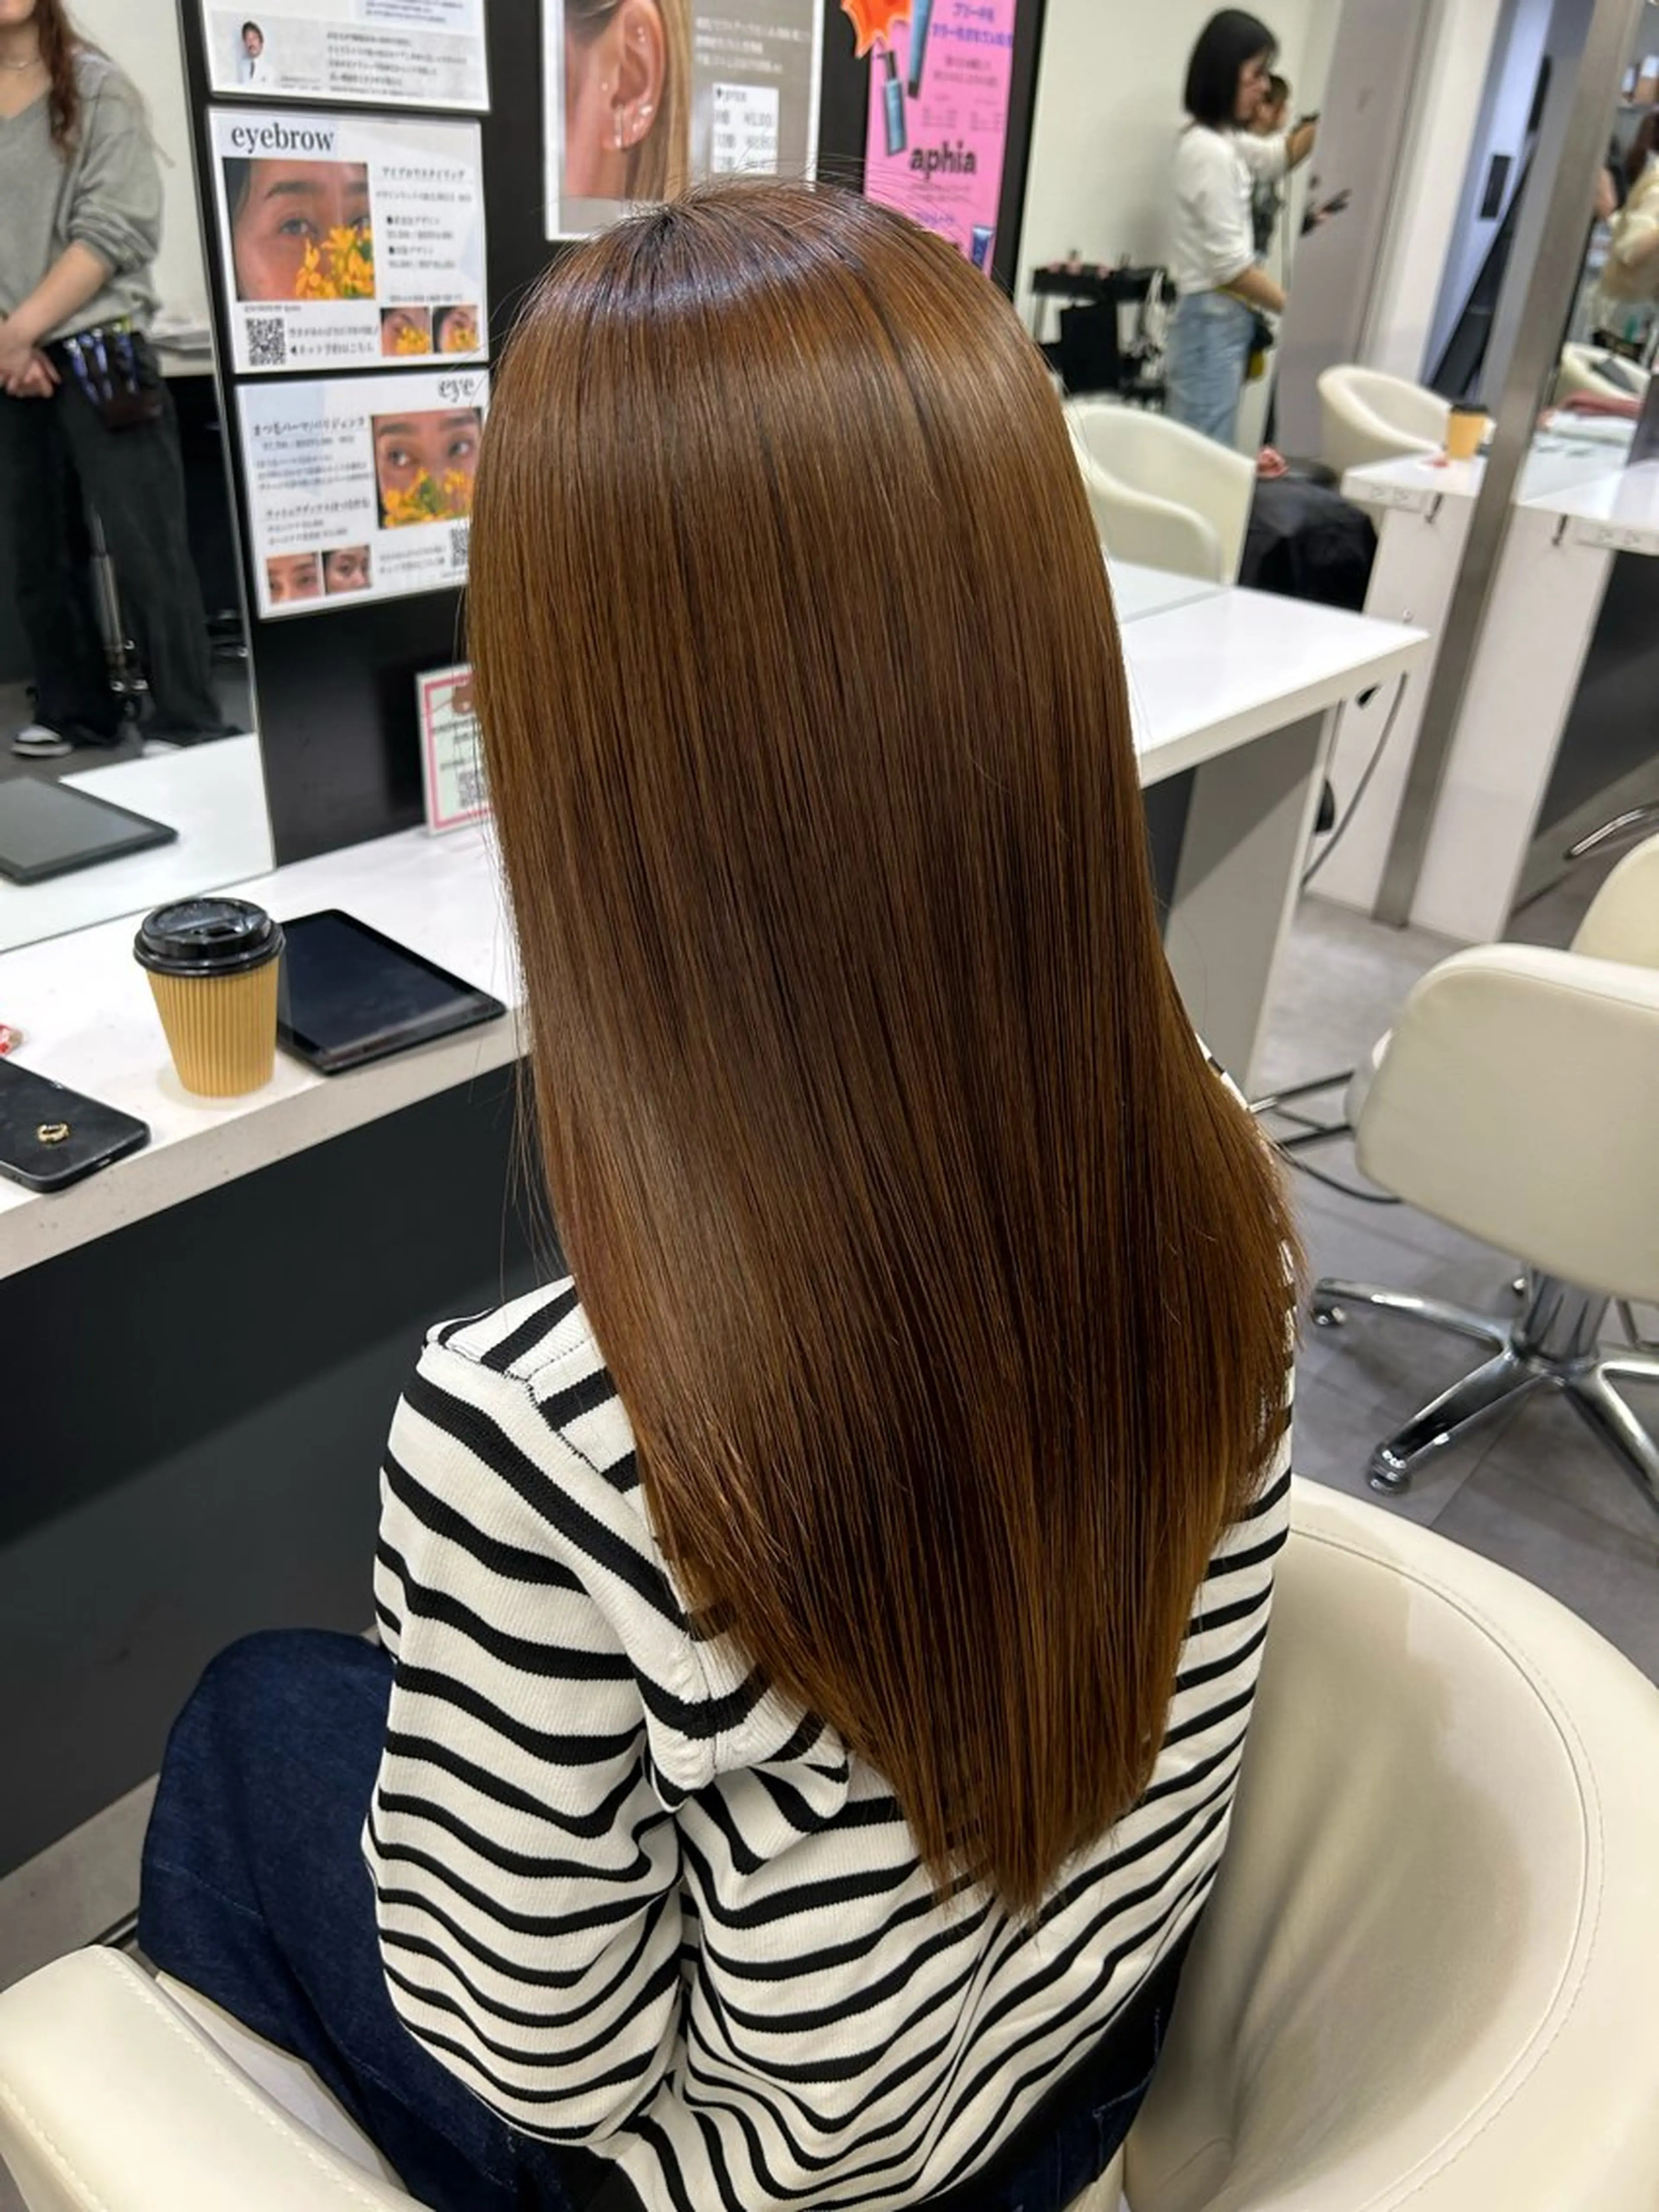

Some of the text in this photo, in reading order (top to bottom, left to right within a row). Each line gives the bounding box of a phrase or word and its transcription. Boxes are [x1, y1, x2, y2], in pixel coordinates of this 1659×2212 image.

[231, 122, 334, 154] eyebrow
[910, 141, 976, 179] aphia
[438, 378, 474, 404] eye
